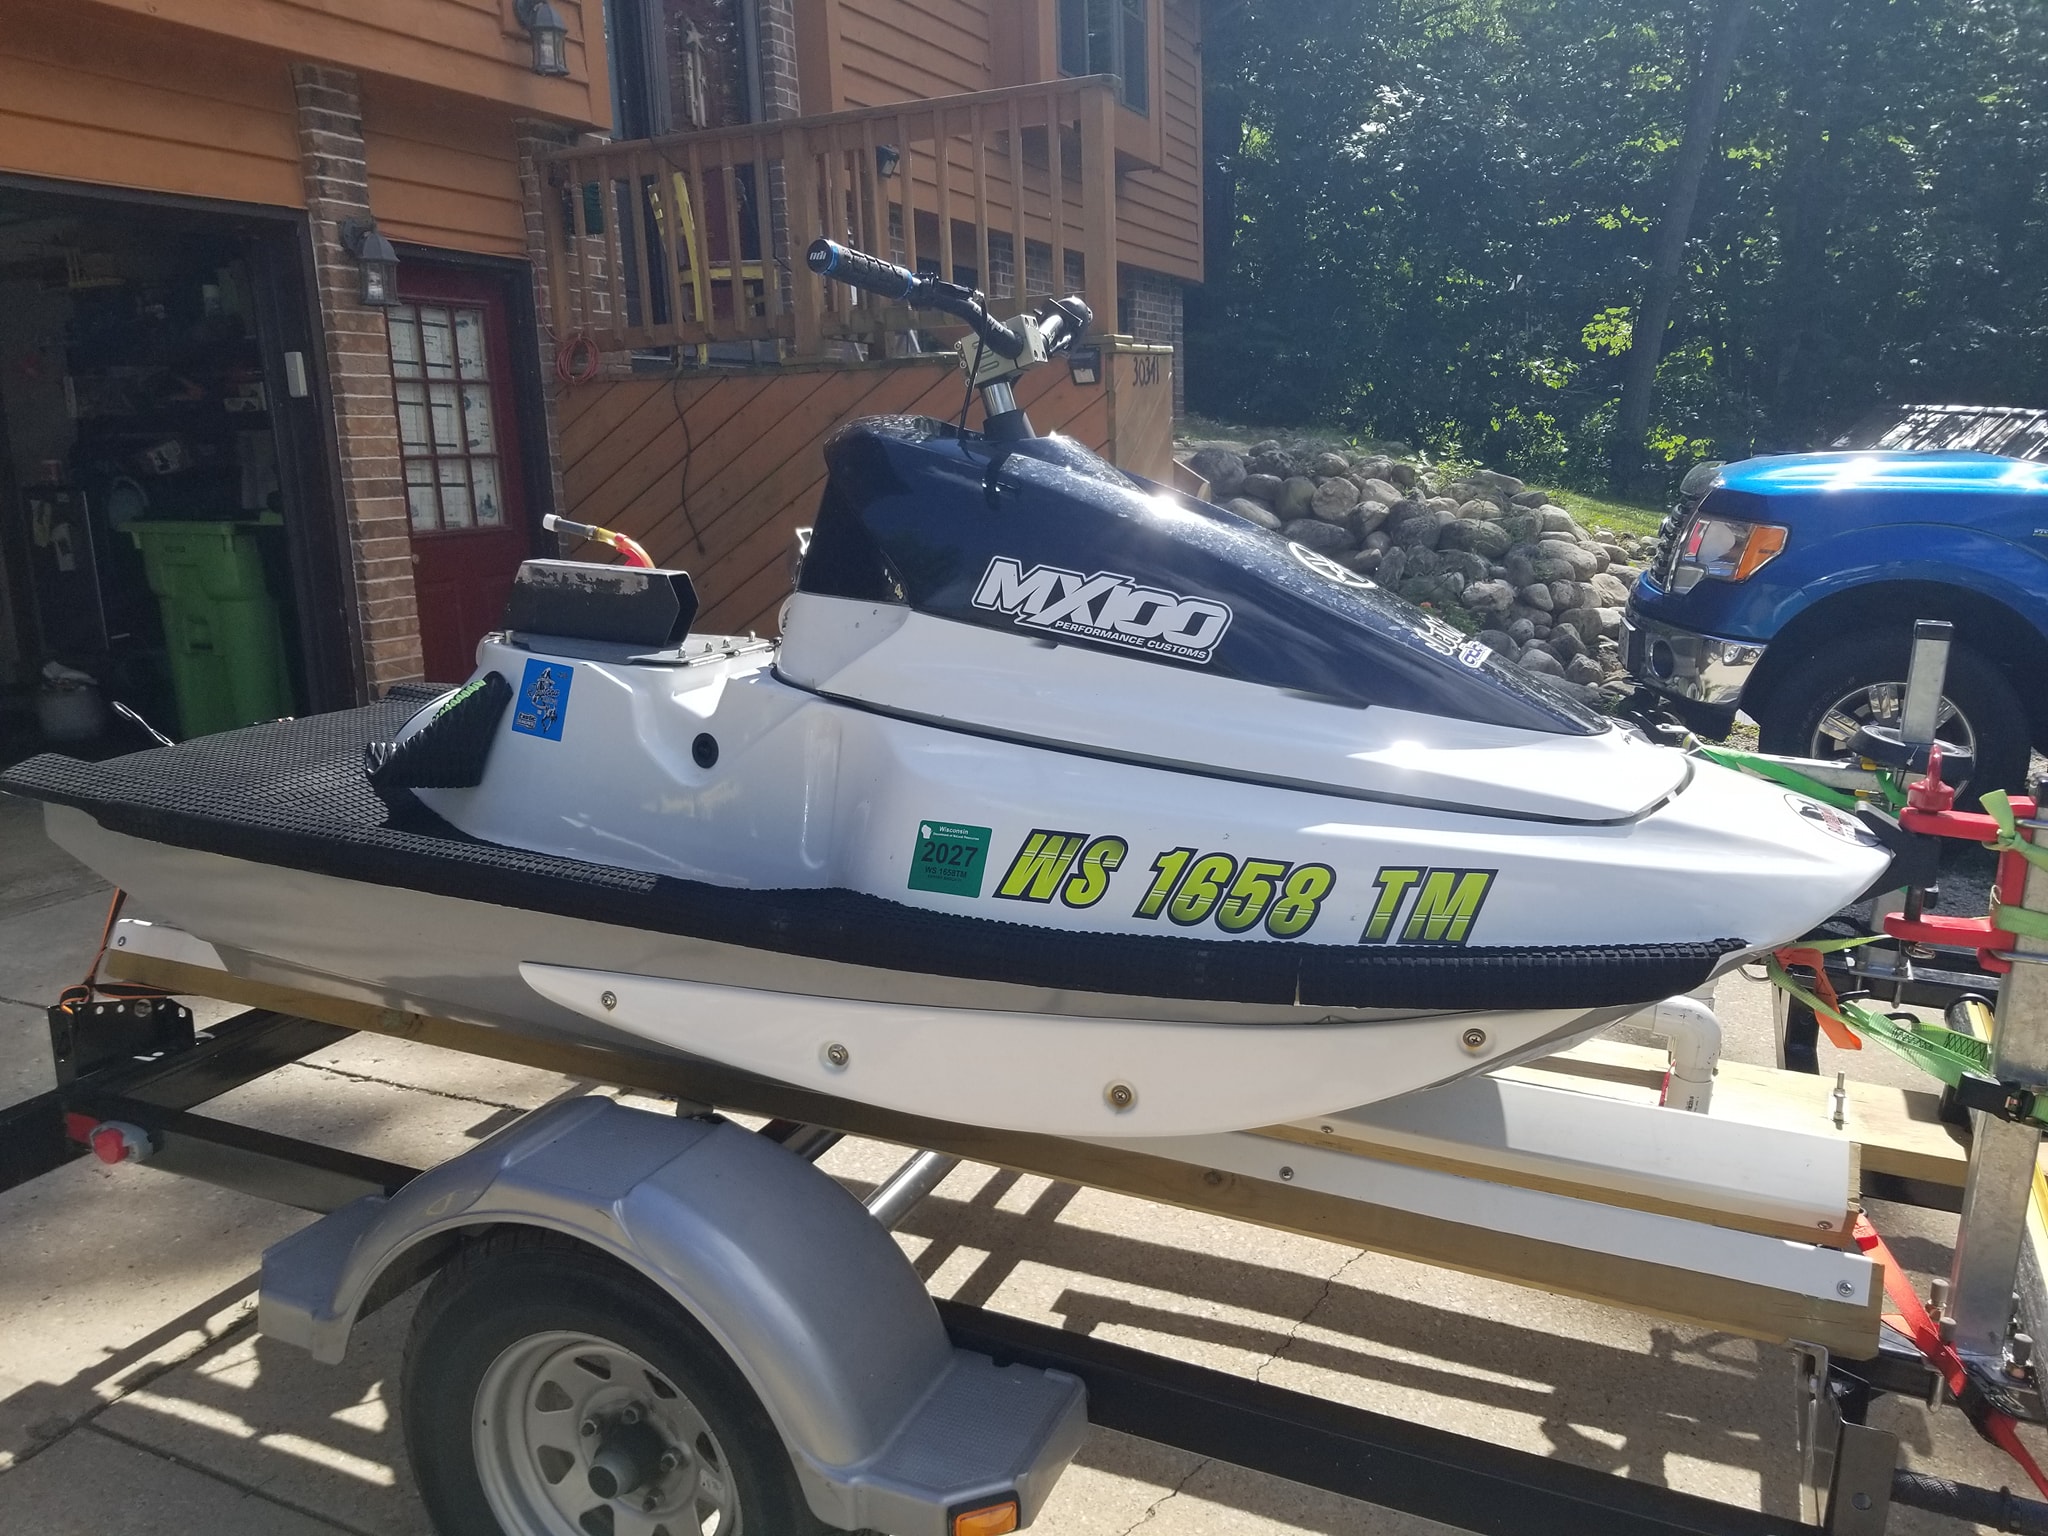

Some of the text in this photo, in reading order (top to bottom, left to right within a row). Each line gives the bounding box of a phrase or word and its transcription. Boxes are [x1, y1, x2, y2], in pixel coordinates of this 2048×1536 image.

[1132, 355, 1160, 387] 30341
[974, 559, 1230, 650] MX100
[1055, 620, 1207, 660] PERFORMANCE CUSTOMS
[939, 826, 969, 835] Wisconsin
[921, 841, 979, 867] 2027
[925, 866, 937, 874] WS
[992, 828, 1499, 945] WS 1658 TM
